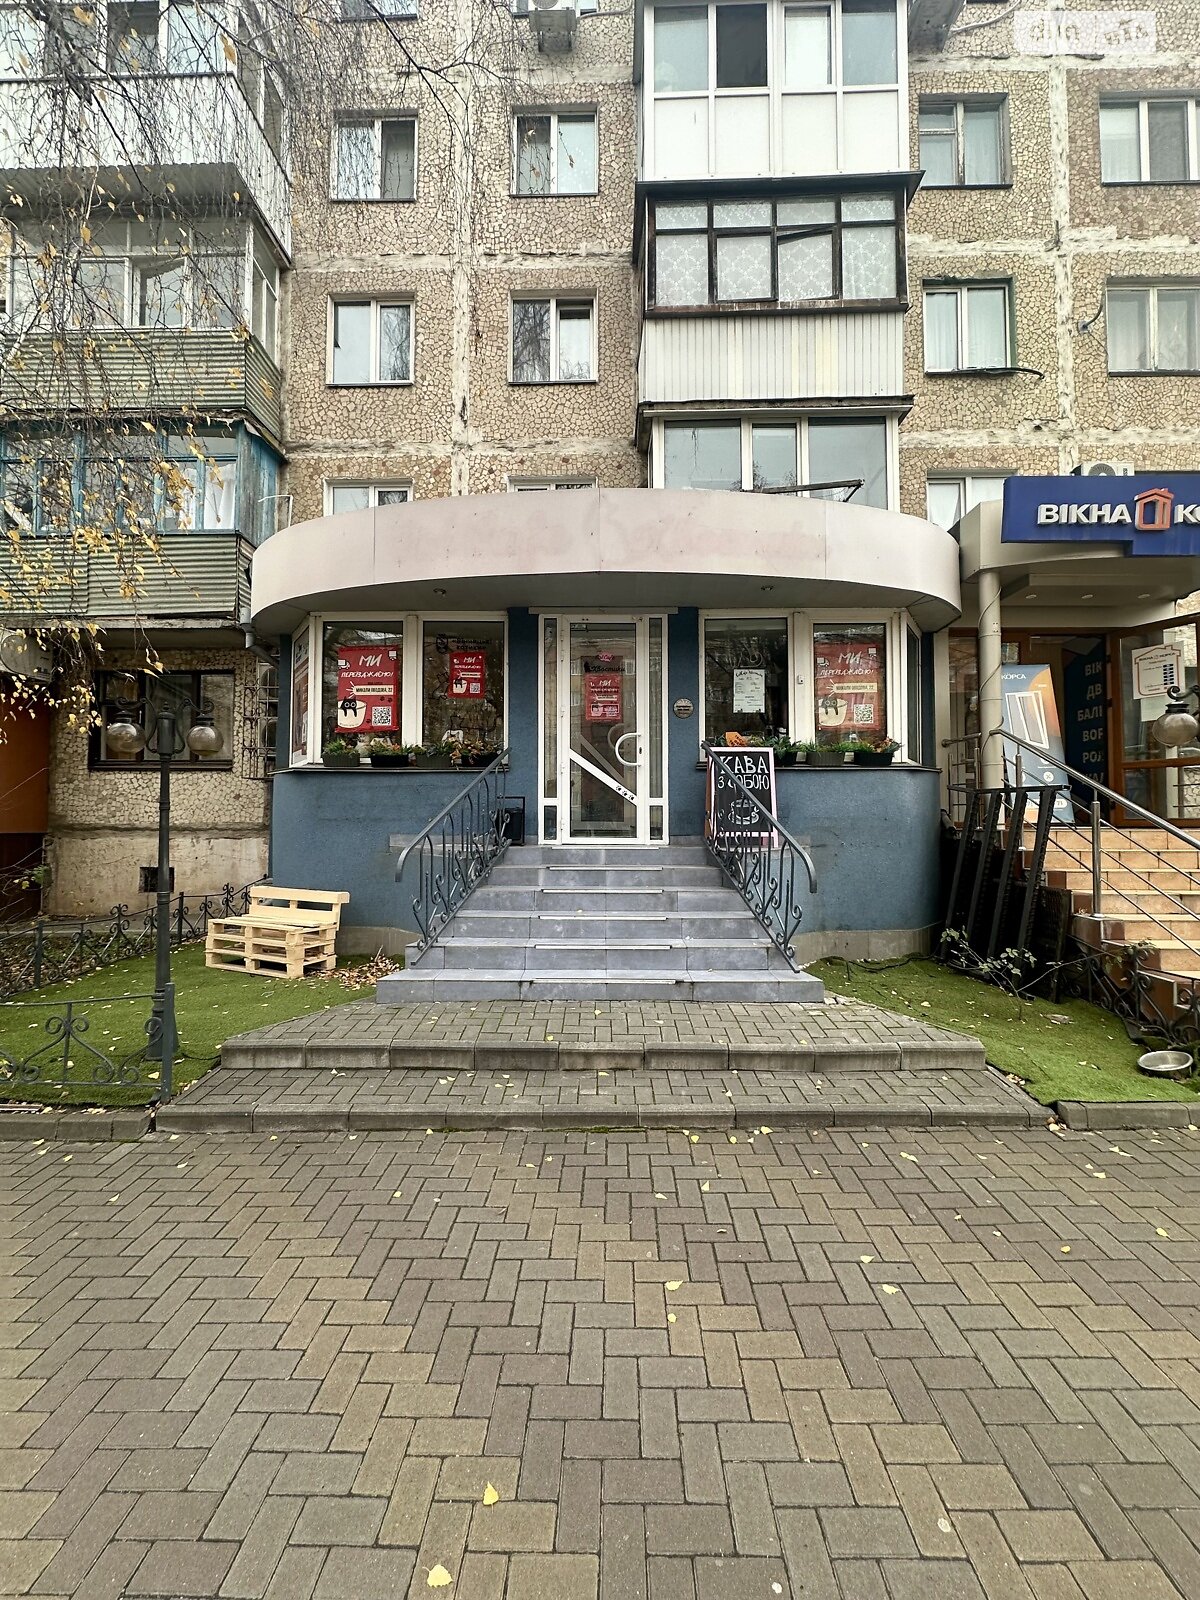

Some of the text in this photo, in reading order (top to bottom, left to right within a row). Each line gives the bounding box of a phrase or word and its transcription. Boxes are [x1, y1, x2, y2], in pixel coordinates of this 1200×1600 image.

[1037, 503, 1132, 525] ВІКНА
[358, 654, 383, 667] МИ
[463, 656, 476, 664] МИ
[838, 651, 862, 664] МИ
[719, 755, 770, 774] КАВА
[717, 775, 725, 789] З
